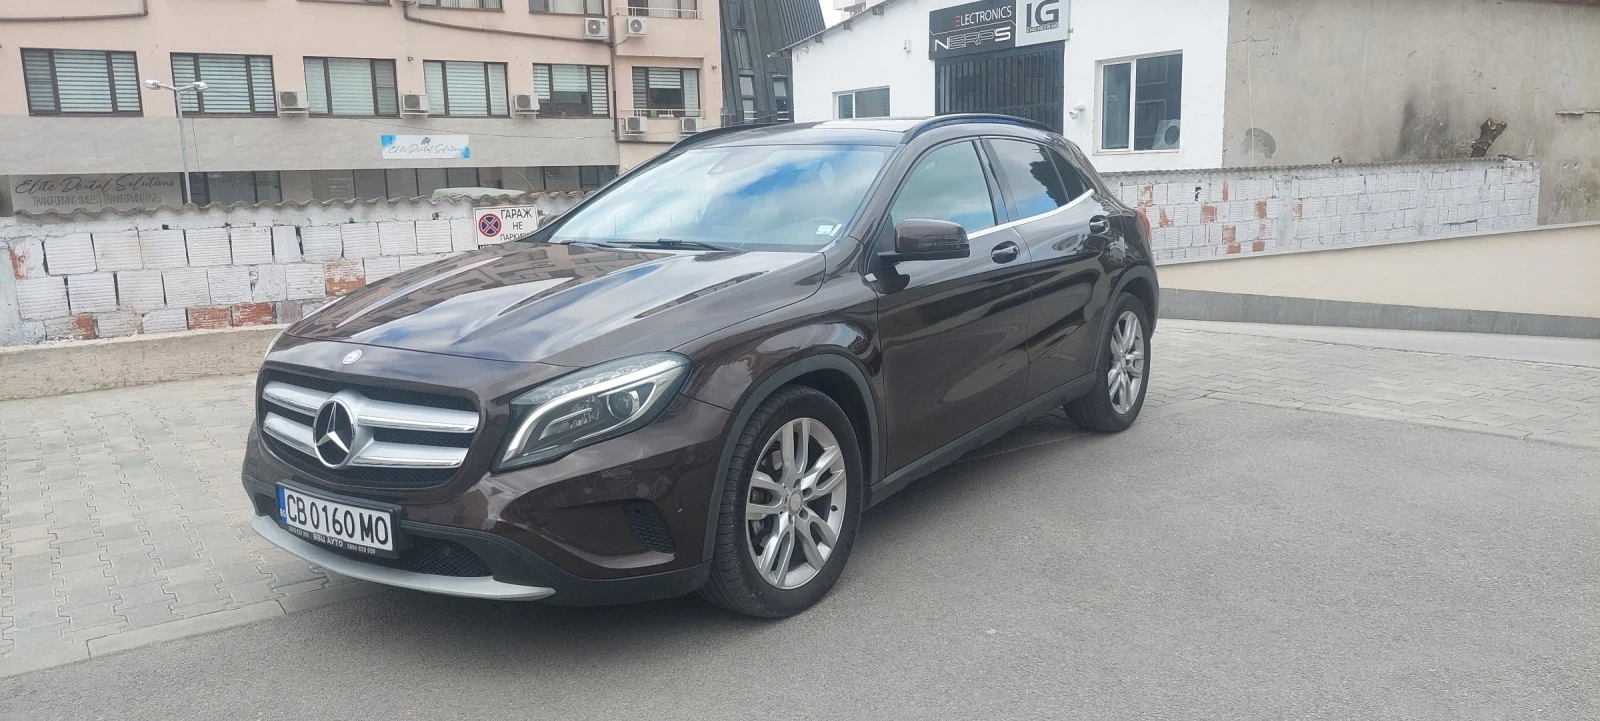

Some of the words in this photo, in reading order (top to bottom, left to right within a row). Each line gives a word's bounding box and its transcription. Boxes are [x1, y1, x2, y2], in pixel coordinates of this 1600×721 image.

[955, 5, 1012, 27] ELECTRONICS
[1026, 0, 1060, 26] IG
[388, 144, 407, 154] Elite
[408, 144, 433, 154] Dental
[15, 179, 57, 194] Elite
[60, 176, 113, 193] Dental
[115, 173, 175, 191] Solutions
[32, 195, 77, 206] TRANSFORMING
[500, 208, 533, 219] ГАРАЖ
[512, 221, 524, 231] НЕ
[310, 501, 356, 539] 0160
